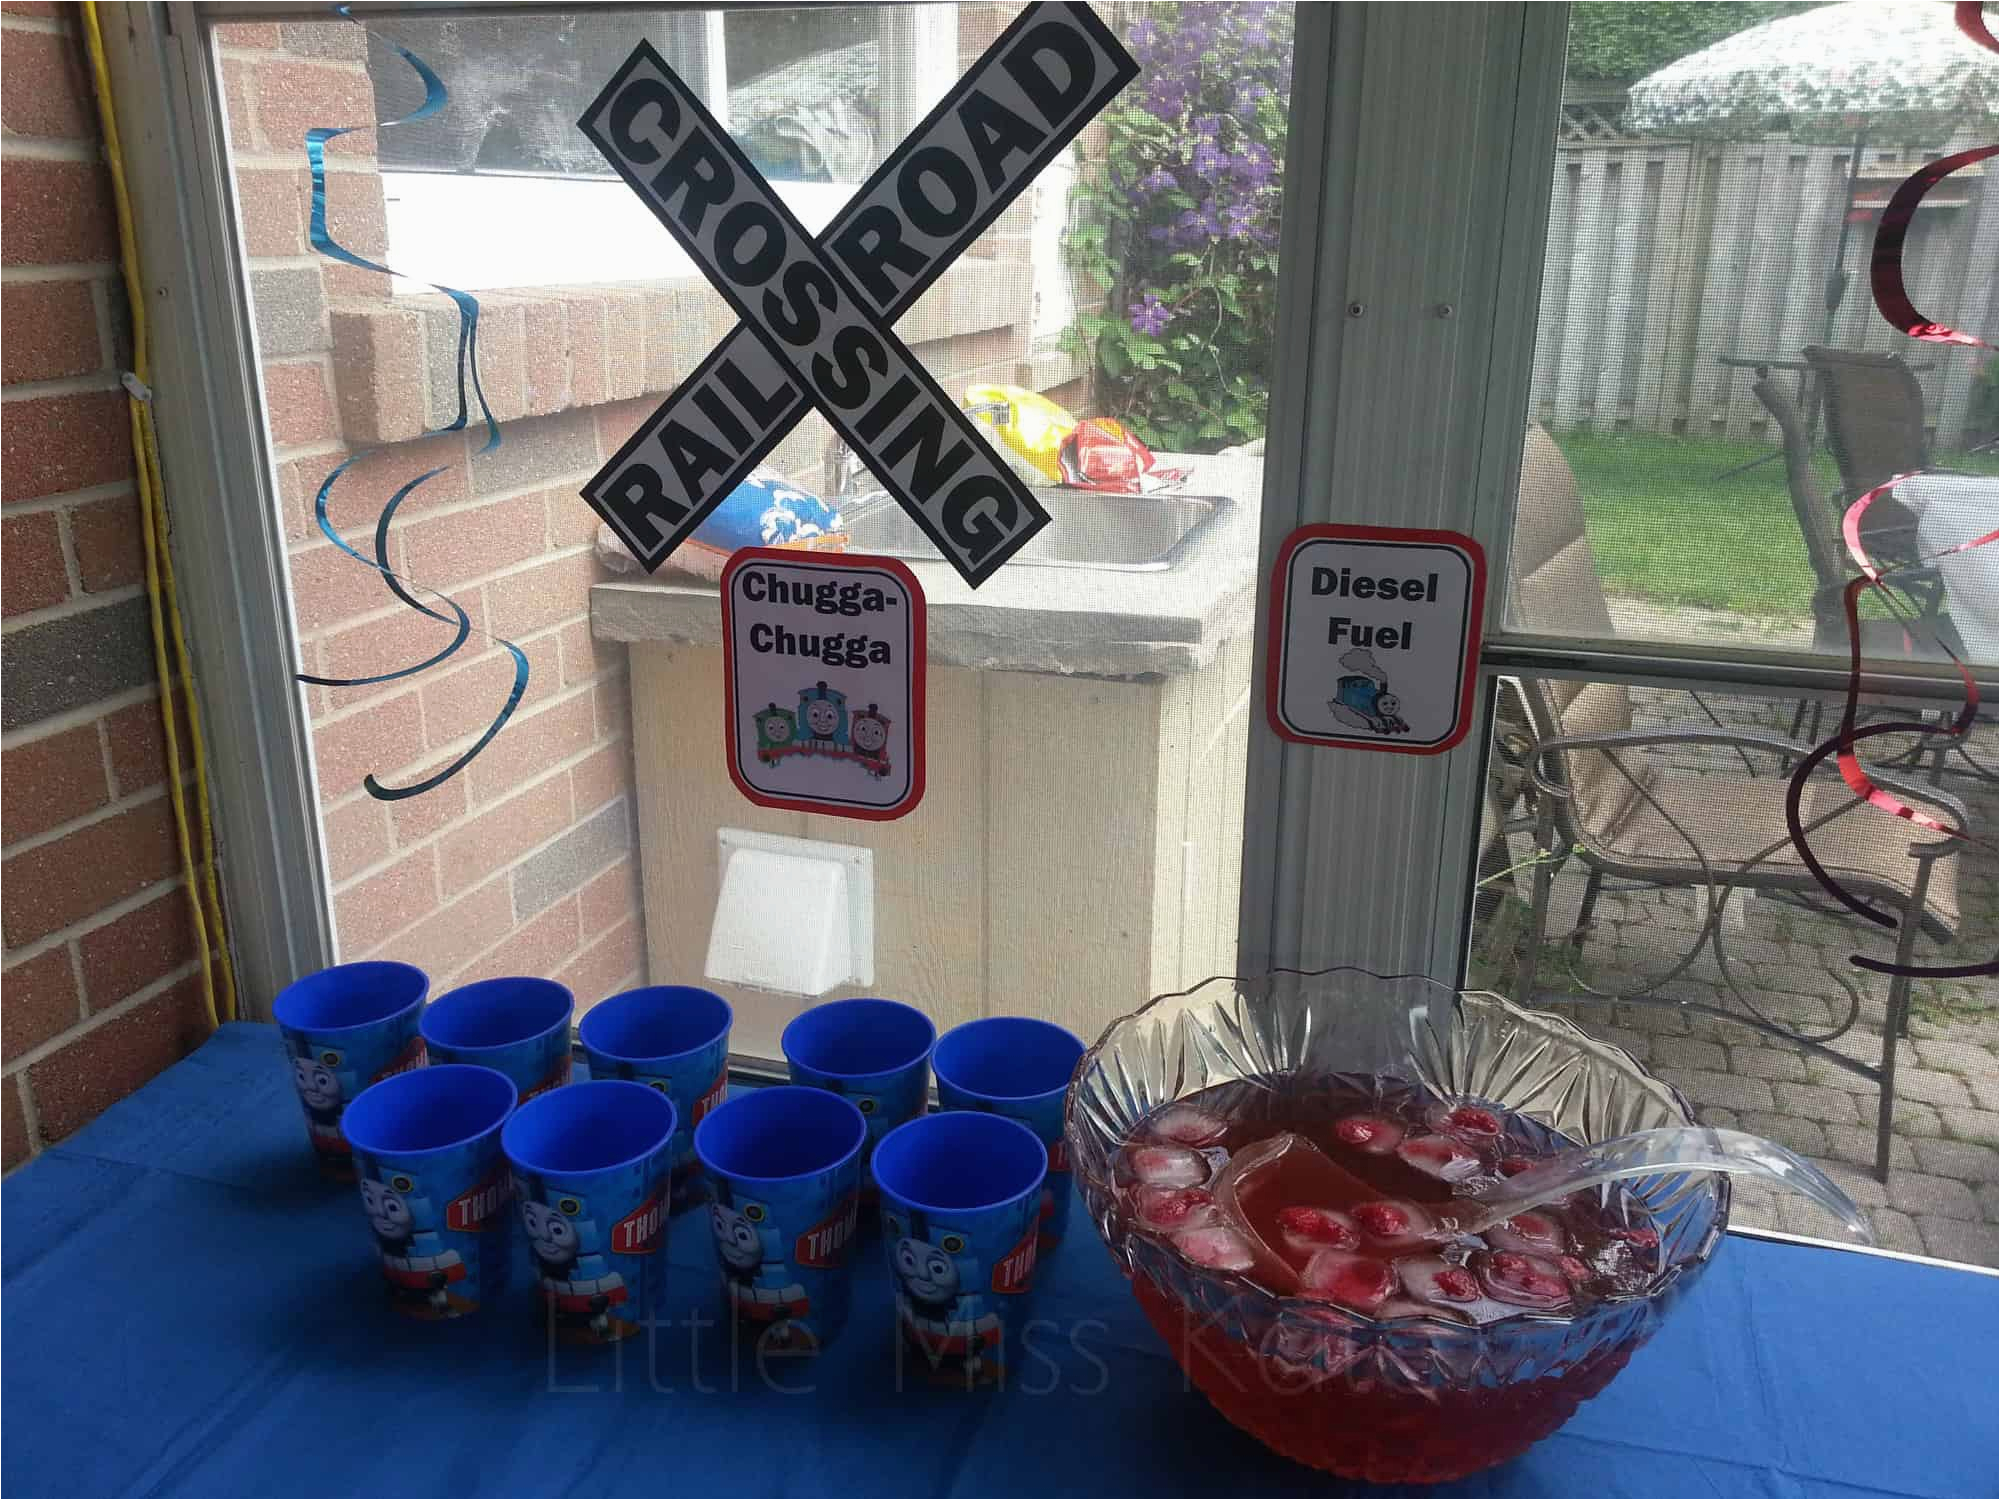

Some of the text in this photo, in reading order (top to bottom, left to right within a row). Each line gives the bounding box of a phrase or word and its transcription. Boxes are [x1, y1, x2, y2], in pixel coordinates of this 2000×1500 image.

[600, 20, 1096, 553] RAIL ROAD
[608, 77, 1018, 563] CROSSING
[742, 570, 897, 616] Chugga-
[1311, 566, 1439, 602] Diesel
[750, 623, 892, 668] Chugga
[1328, 616, 1413, 650] Fuel
